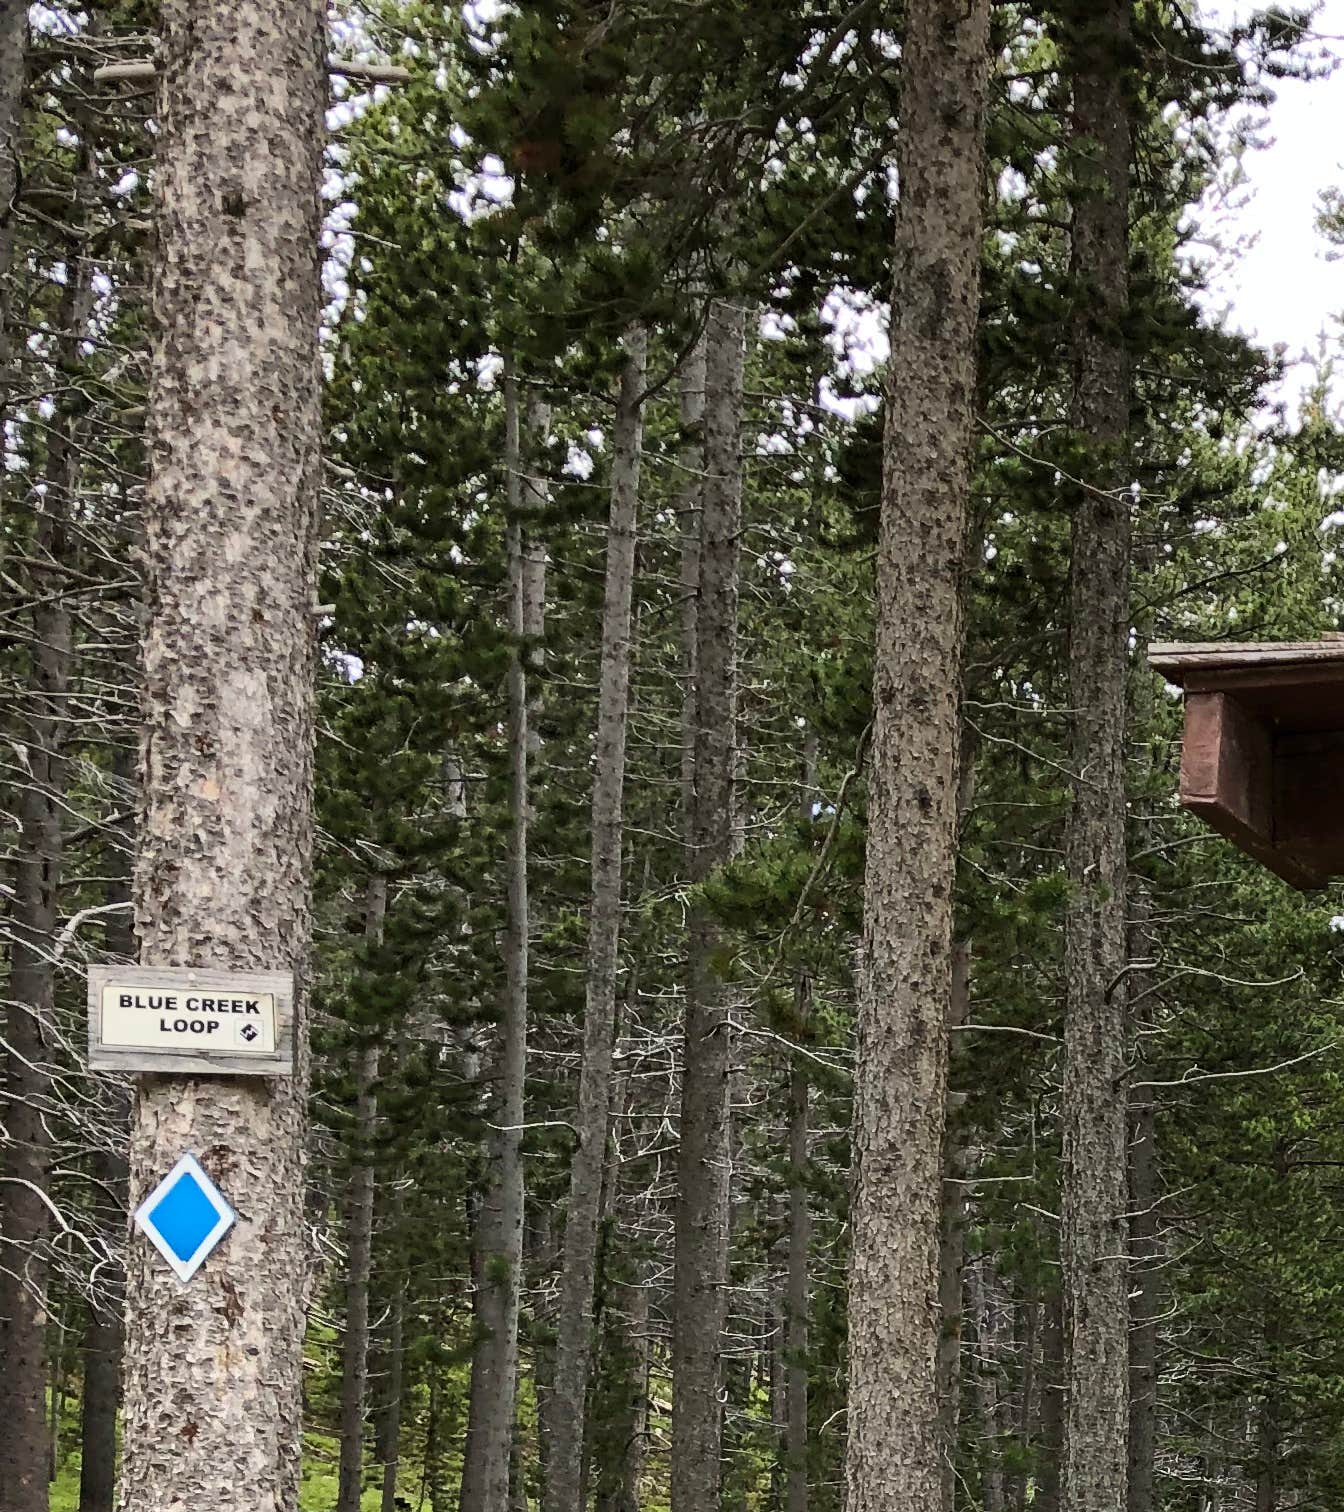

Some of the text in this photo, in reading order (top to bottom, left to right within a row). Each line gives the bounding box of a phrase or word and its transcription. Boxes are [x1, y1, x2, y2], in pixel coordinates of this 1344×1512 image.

[119, 994, 261, 1014] BLUE CREEK
[160, 1018, 220, 1034] LOOP
